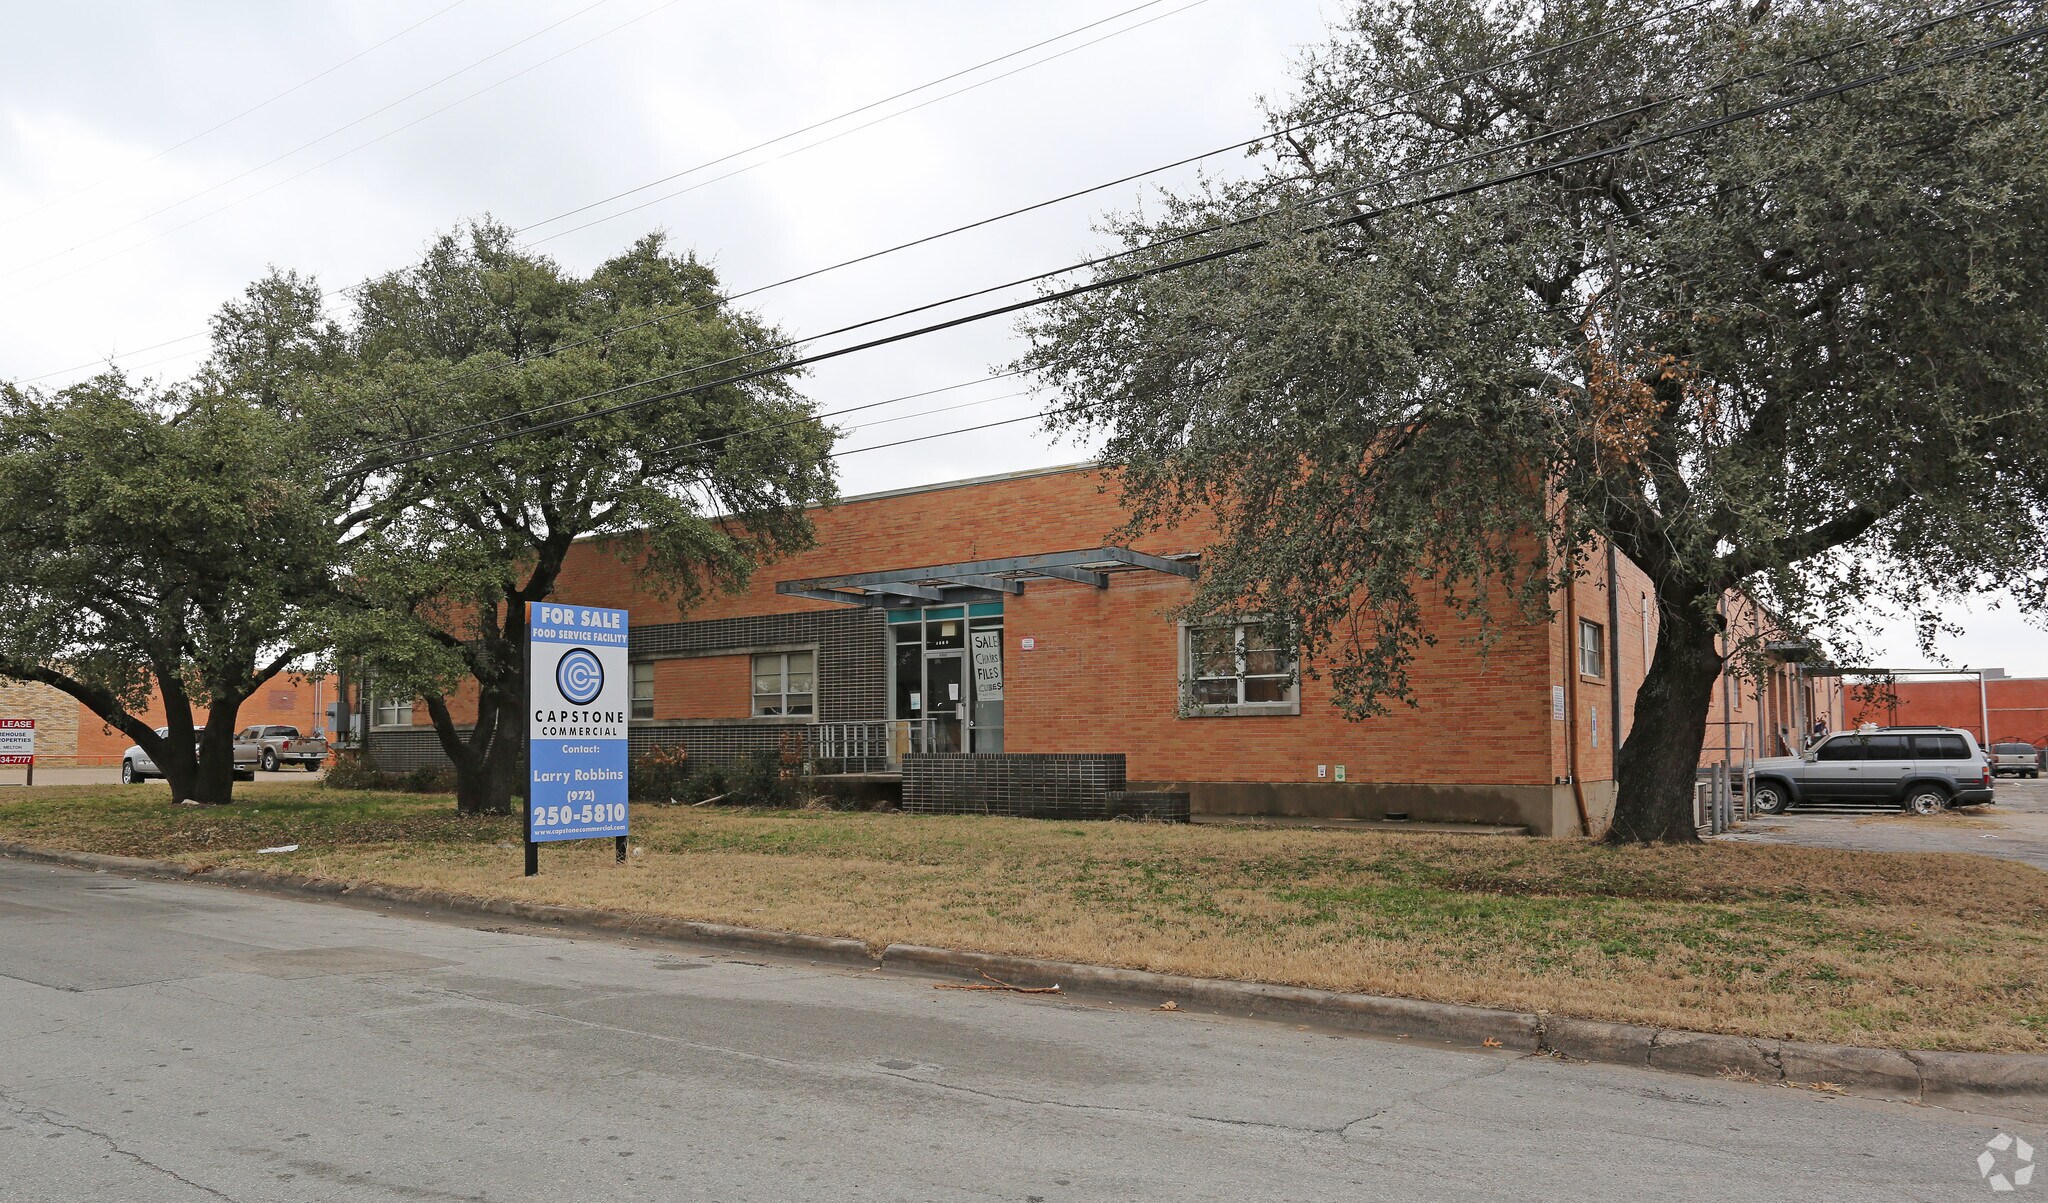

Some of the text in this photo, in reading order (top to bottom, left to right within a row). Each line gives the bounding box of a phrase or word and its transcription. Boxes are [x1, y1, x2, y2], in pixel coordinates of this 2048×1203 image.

[541, 607, 620, 629] FOR SALE
[532, 628, 627, 643] FOOD SERVICE FACILITY
[975, 635, 999, 648] SALE
[977, 666, 999, 680] FILES
[535, 710, 624, 723] CAPSTONE
[542, 727, 617, 736] COMMERCIAL
[562, 744, 600, 754] Contact:
[533, 768, 624, 784] Larry Robbins
[567, 790, 595, 802] (972)
[533, 803, 626, 826] 250-5810
[534, 825, 626, 836] www.capstonecommercial.com
